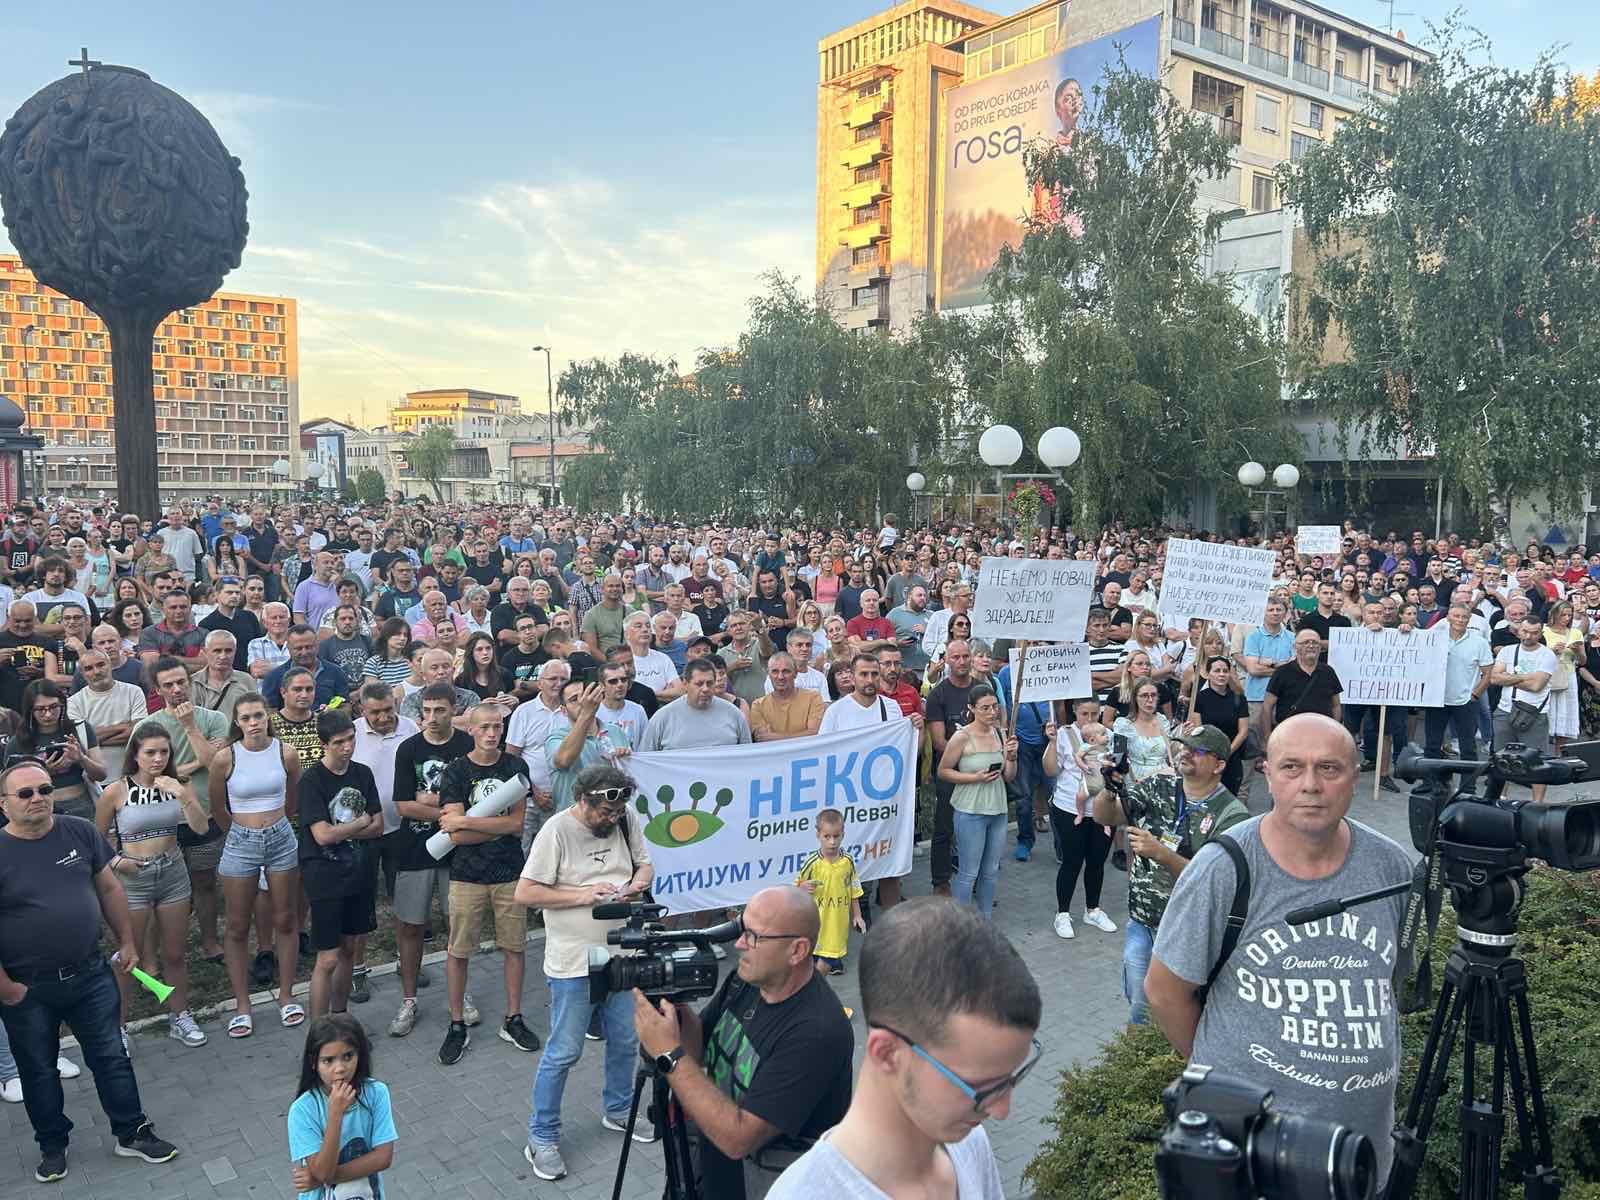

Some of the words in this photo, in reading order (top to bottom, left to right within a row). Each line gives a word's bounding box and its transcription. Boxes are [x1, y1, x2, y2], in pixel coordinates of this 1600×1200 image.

[954, 106, 969, 119] OD
[971, 95, 1005, 114] PRVOG
[1007, 79, 1050, 103] KORAKA
[954, 119, 969, 134] DO
[971, 112, 996, 129] PRVE
[997, 98, 1039, 120] POBEDE
[954, 125, 1022, 168] rosa
[989, 569, 1048, 587] НЕЋЕМО
[1050, 570, 1093, 587] НОВАЦ
[1006, 590, 1053, 603] ХОЋЕМО
[1030, 664, 1041, 673] СЕ
[1348, 679, 1426, 703] БЕДНИЦИ!
[746, 816, 809, 841] брине
[654, 862, 751, 895] ИТИЈУМ
[759, 858, 773, 879] У
[863, 837, 894, 862] НЕ!
[1400, 891, 1421, 949] Panasonic
[1245, 912, 1393, 967] ORIGINAL
[1282, 955, 1328, 970] Denim
[1328, 955, 1369, 969] Wear
[1280, 1015, 1384, 1049] REG.TM
[1249, 1043, 1338, 1090] Exclusive
[1300, 1050, 1338, 1063] BANANI
[1341, 1055, 1369, 1065] JEANS
